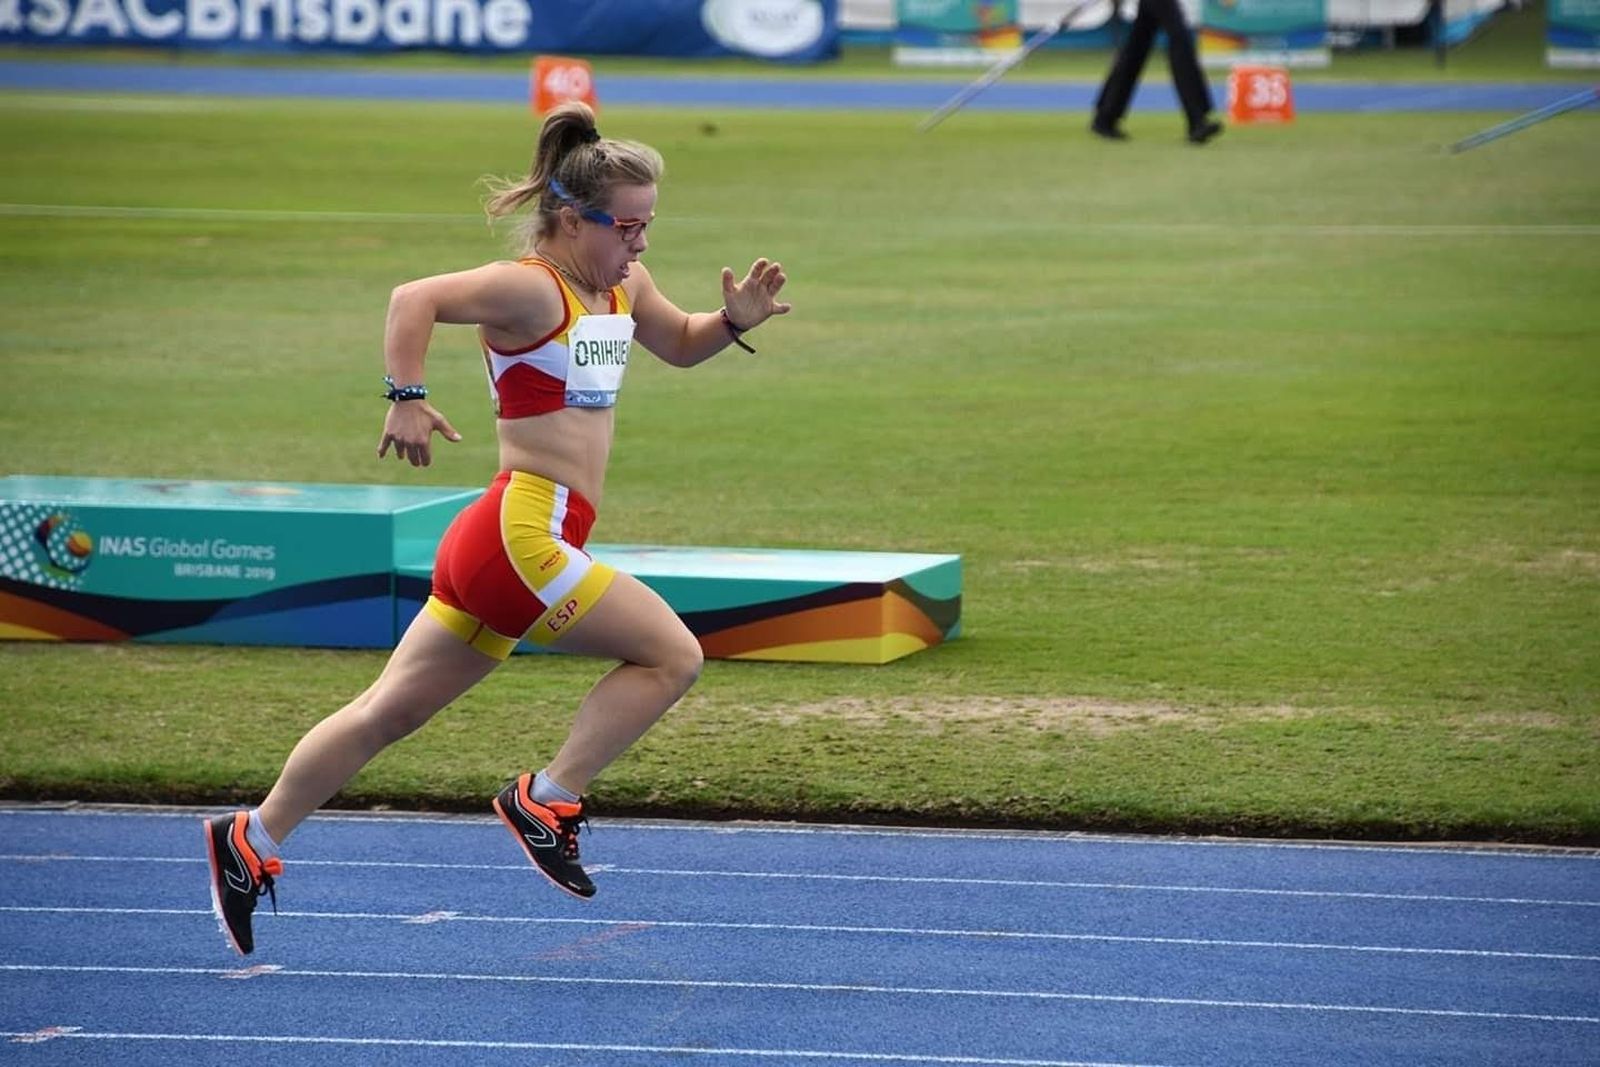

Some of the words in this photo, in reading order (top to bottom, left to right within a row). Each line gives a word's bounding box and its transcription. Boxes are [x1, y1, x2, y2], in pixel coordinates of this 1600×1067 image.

[544, 66, 590, 97] 40
[1249, 75, 1286, 108] 35
[99, 536, 146, 556] INAS
[149, 537, 209, 558] Global
[211, 539, 275, 560] Games
[174, 564, 240, 577] BRISBANE
[243, 567, 275, 580] 2019
[546, 599, 578, 632] ESP
